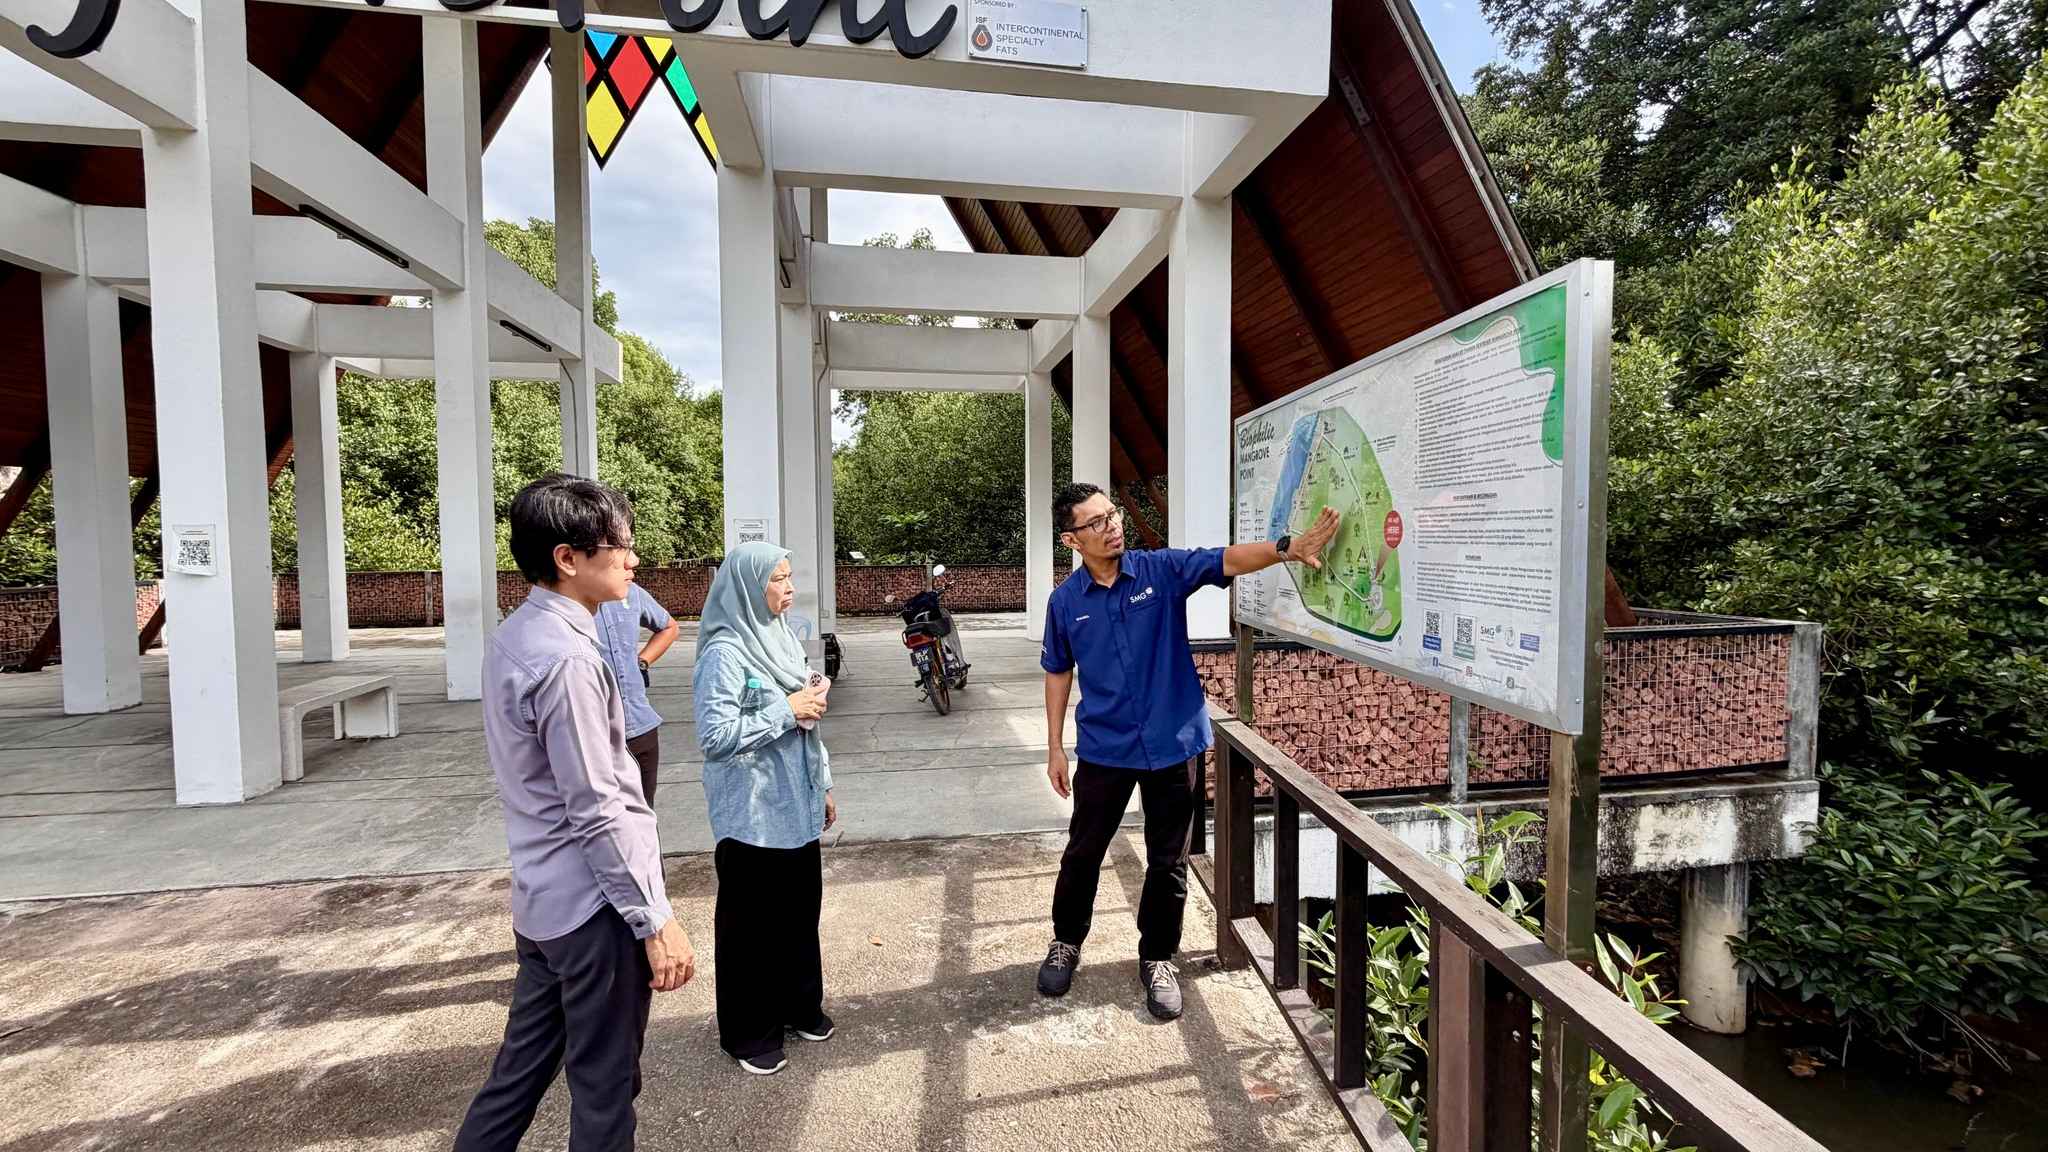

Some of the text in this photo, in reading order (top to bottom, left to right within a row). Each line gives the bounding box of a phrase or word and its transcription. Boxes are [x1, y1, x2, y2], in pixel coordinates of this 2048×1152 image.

[996, 23, 1084, 40] INTERCONTINENTAL
[996, 34, 1045, 47] SPECIALTY
[996, 45, 1018, 56] FATS
[1240, 446, 1270, 464] MANGROVE
[1240, 467, 1255, 480] POINT
[1129, 592, 1147, 604] SMG
[1480, 625, 1495, 636] SMG
